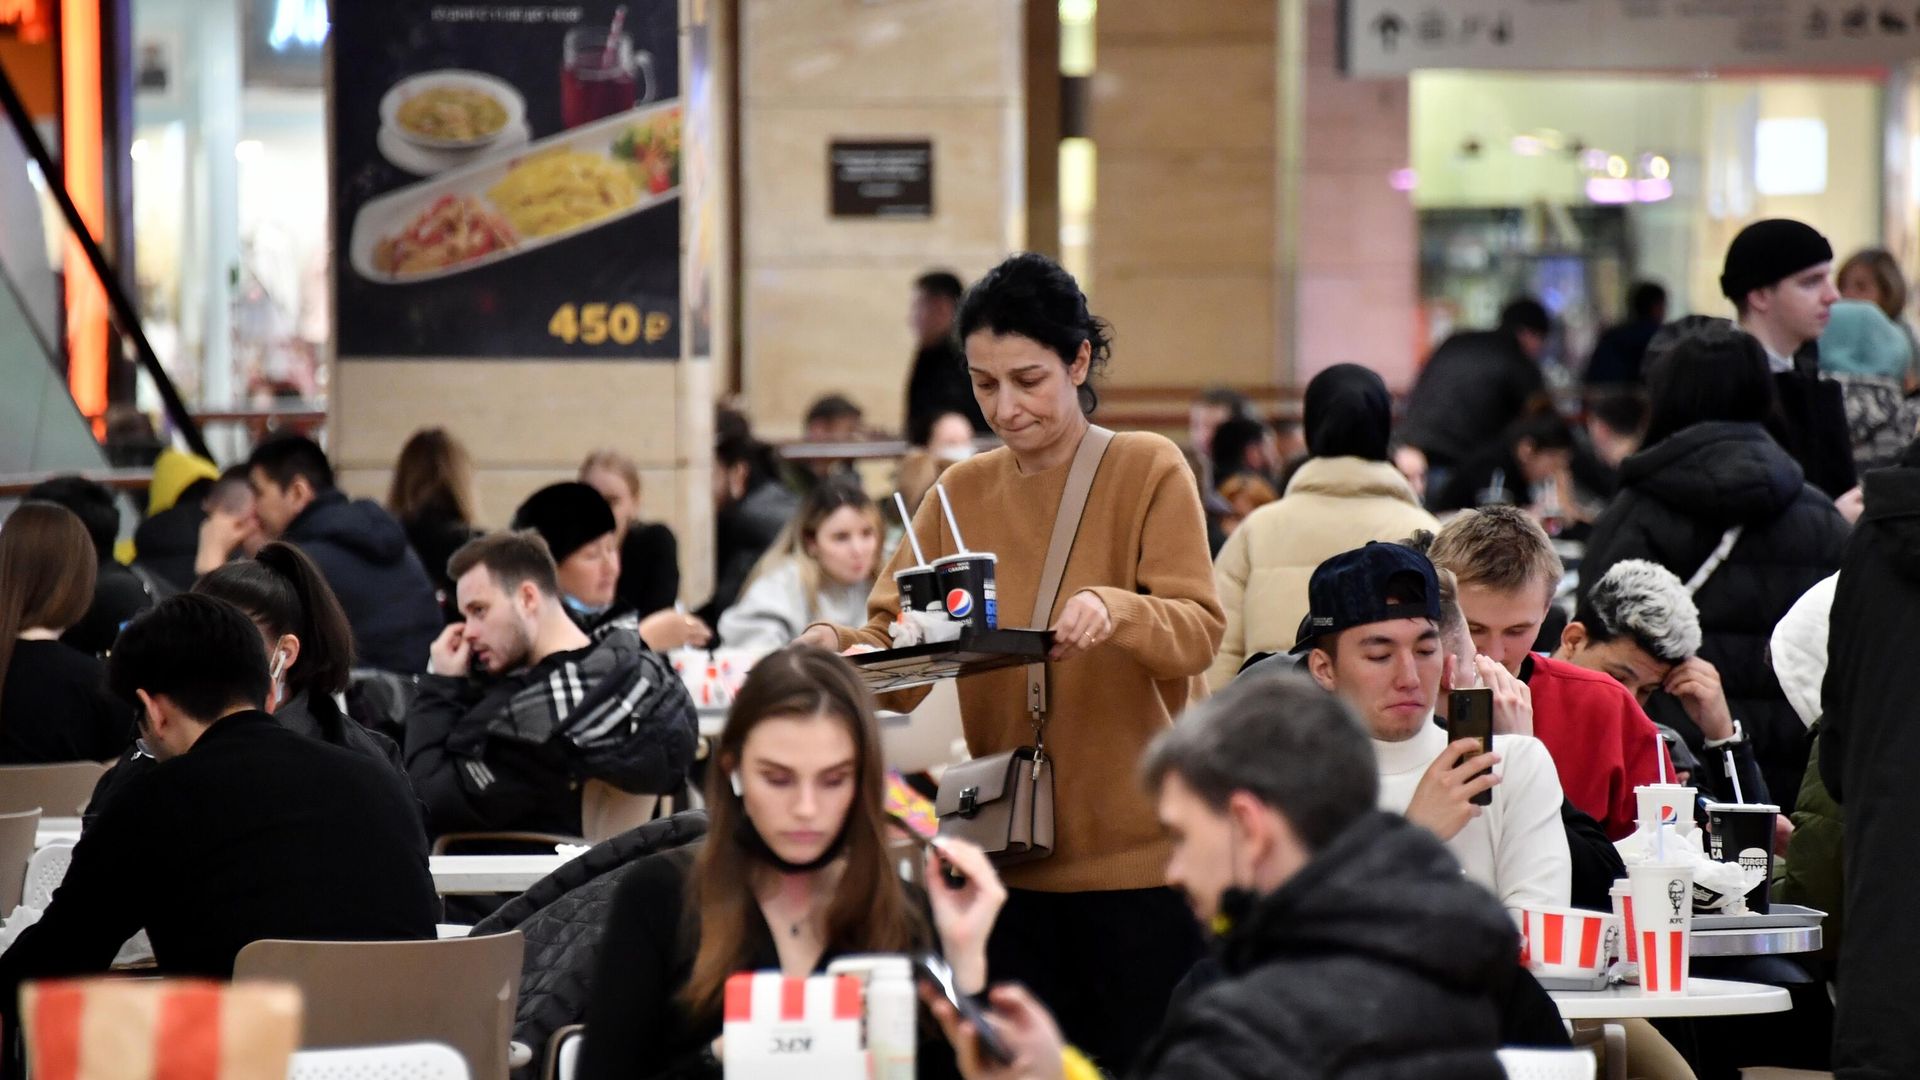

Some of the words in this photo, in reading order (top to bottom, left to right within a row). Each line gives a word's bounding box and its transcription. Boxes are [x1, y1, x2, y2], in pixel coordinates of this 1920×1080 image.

[548, 302, 639, 345] 450
[1738, 857, 1768, 866] BURGER
[1669, 917, 1684, 925] KFC
[769, 1037, 813, 1054] KFC
